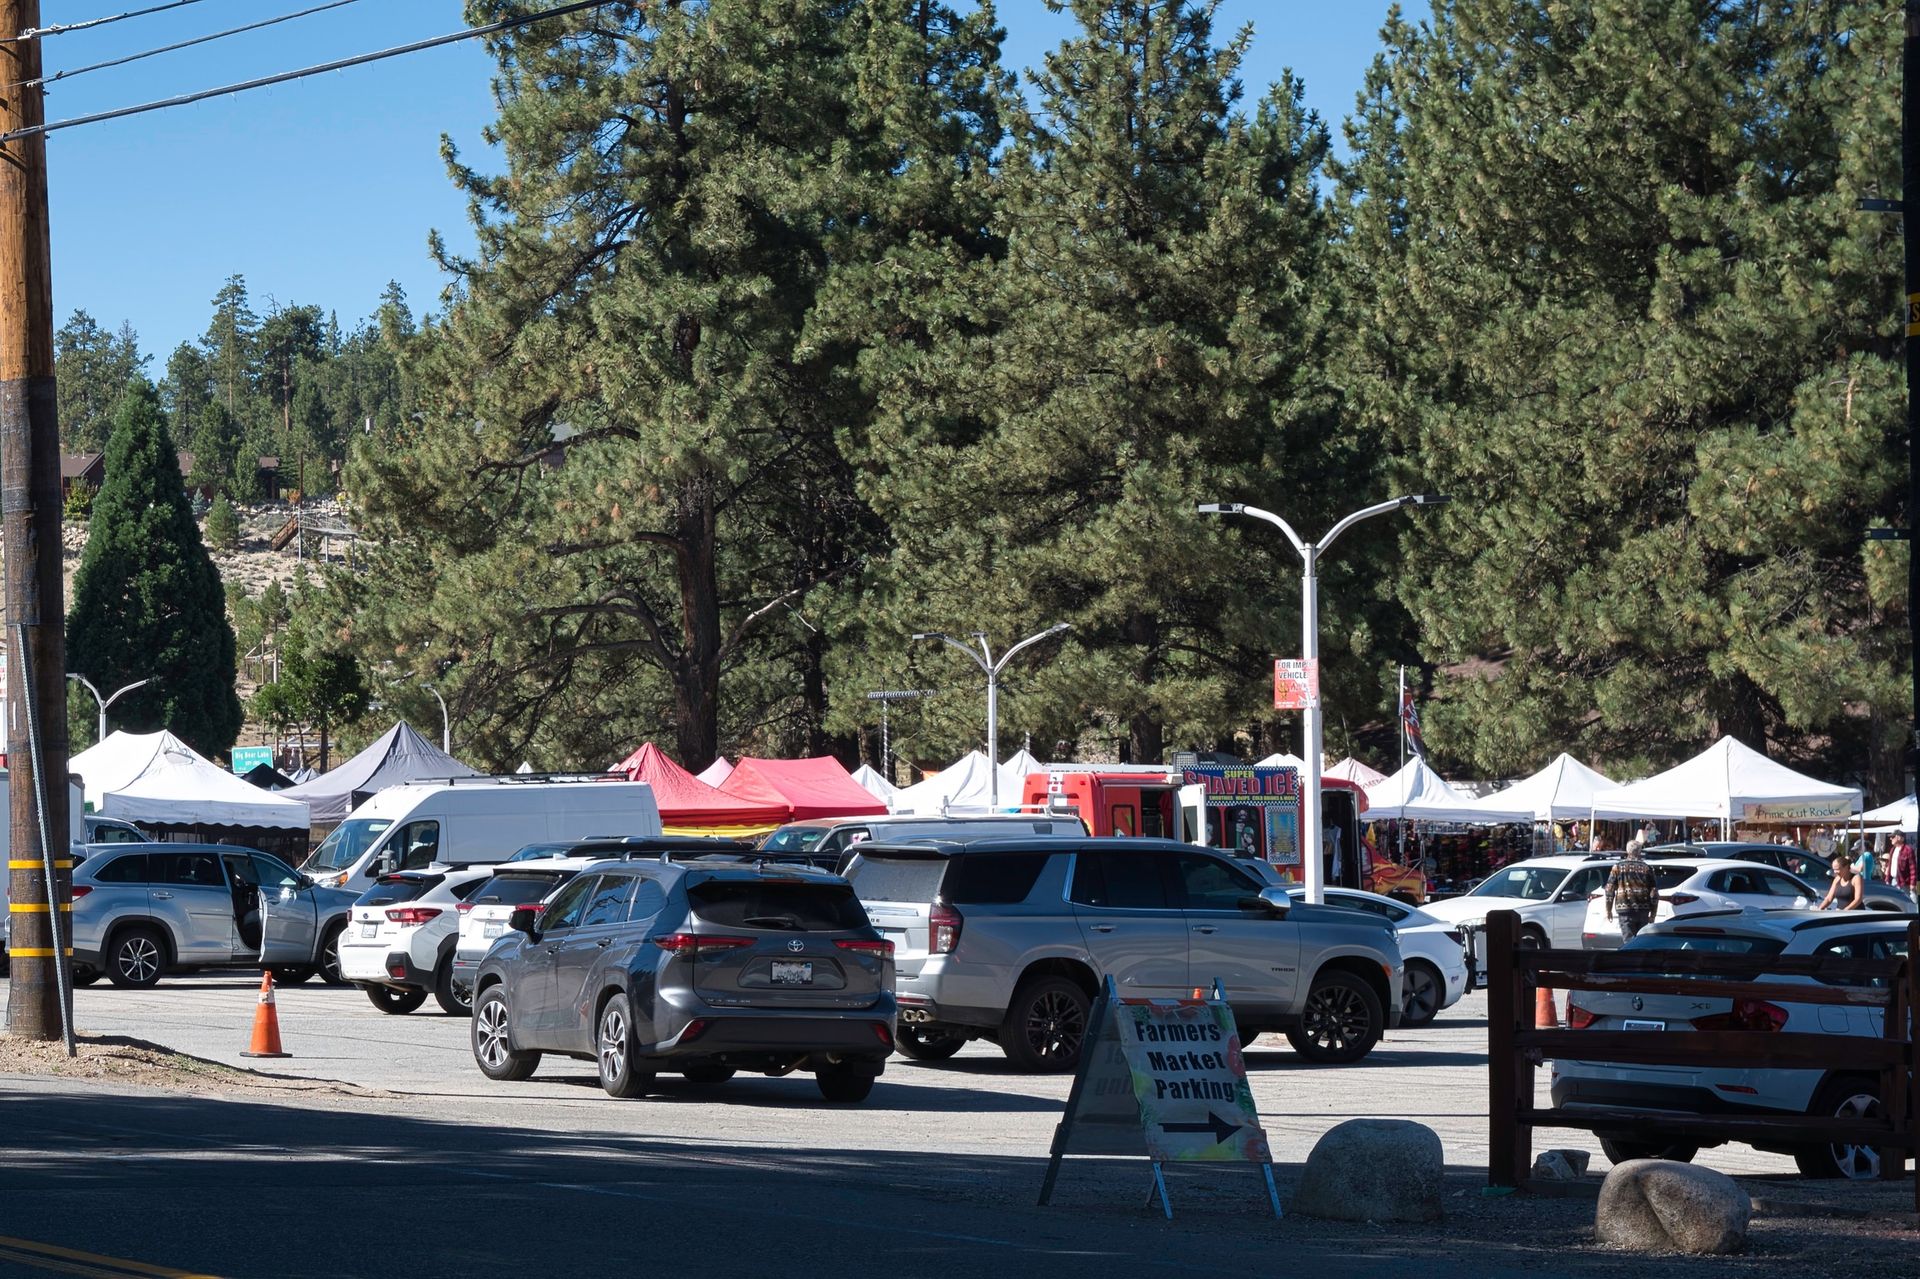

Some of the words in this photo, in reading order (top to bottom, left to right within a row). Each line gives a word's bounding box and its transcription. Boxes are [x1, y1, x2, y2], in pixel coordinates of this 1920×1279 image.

[1184, 770, 1261, 795] SHAVED
[1265, 770, 1296, 795] ICE
[1224, 770, 1254, 778] SUPER
[1756, 804, 1785, 819] Prime
[1787, 806, 1807, 818] Cut
[1809, 803, 1841, 817] Rocks
[1134, 1021, 1221, 1042] Farmers
[1147, 1051, 1227, 1071] Market
[1154, 1078, 1234, 1103] Parking
